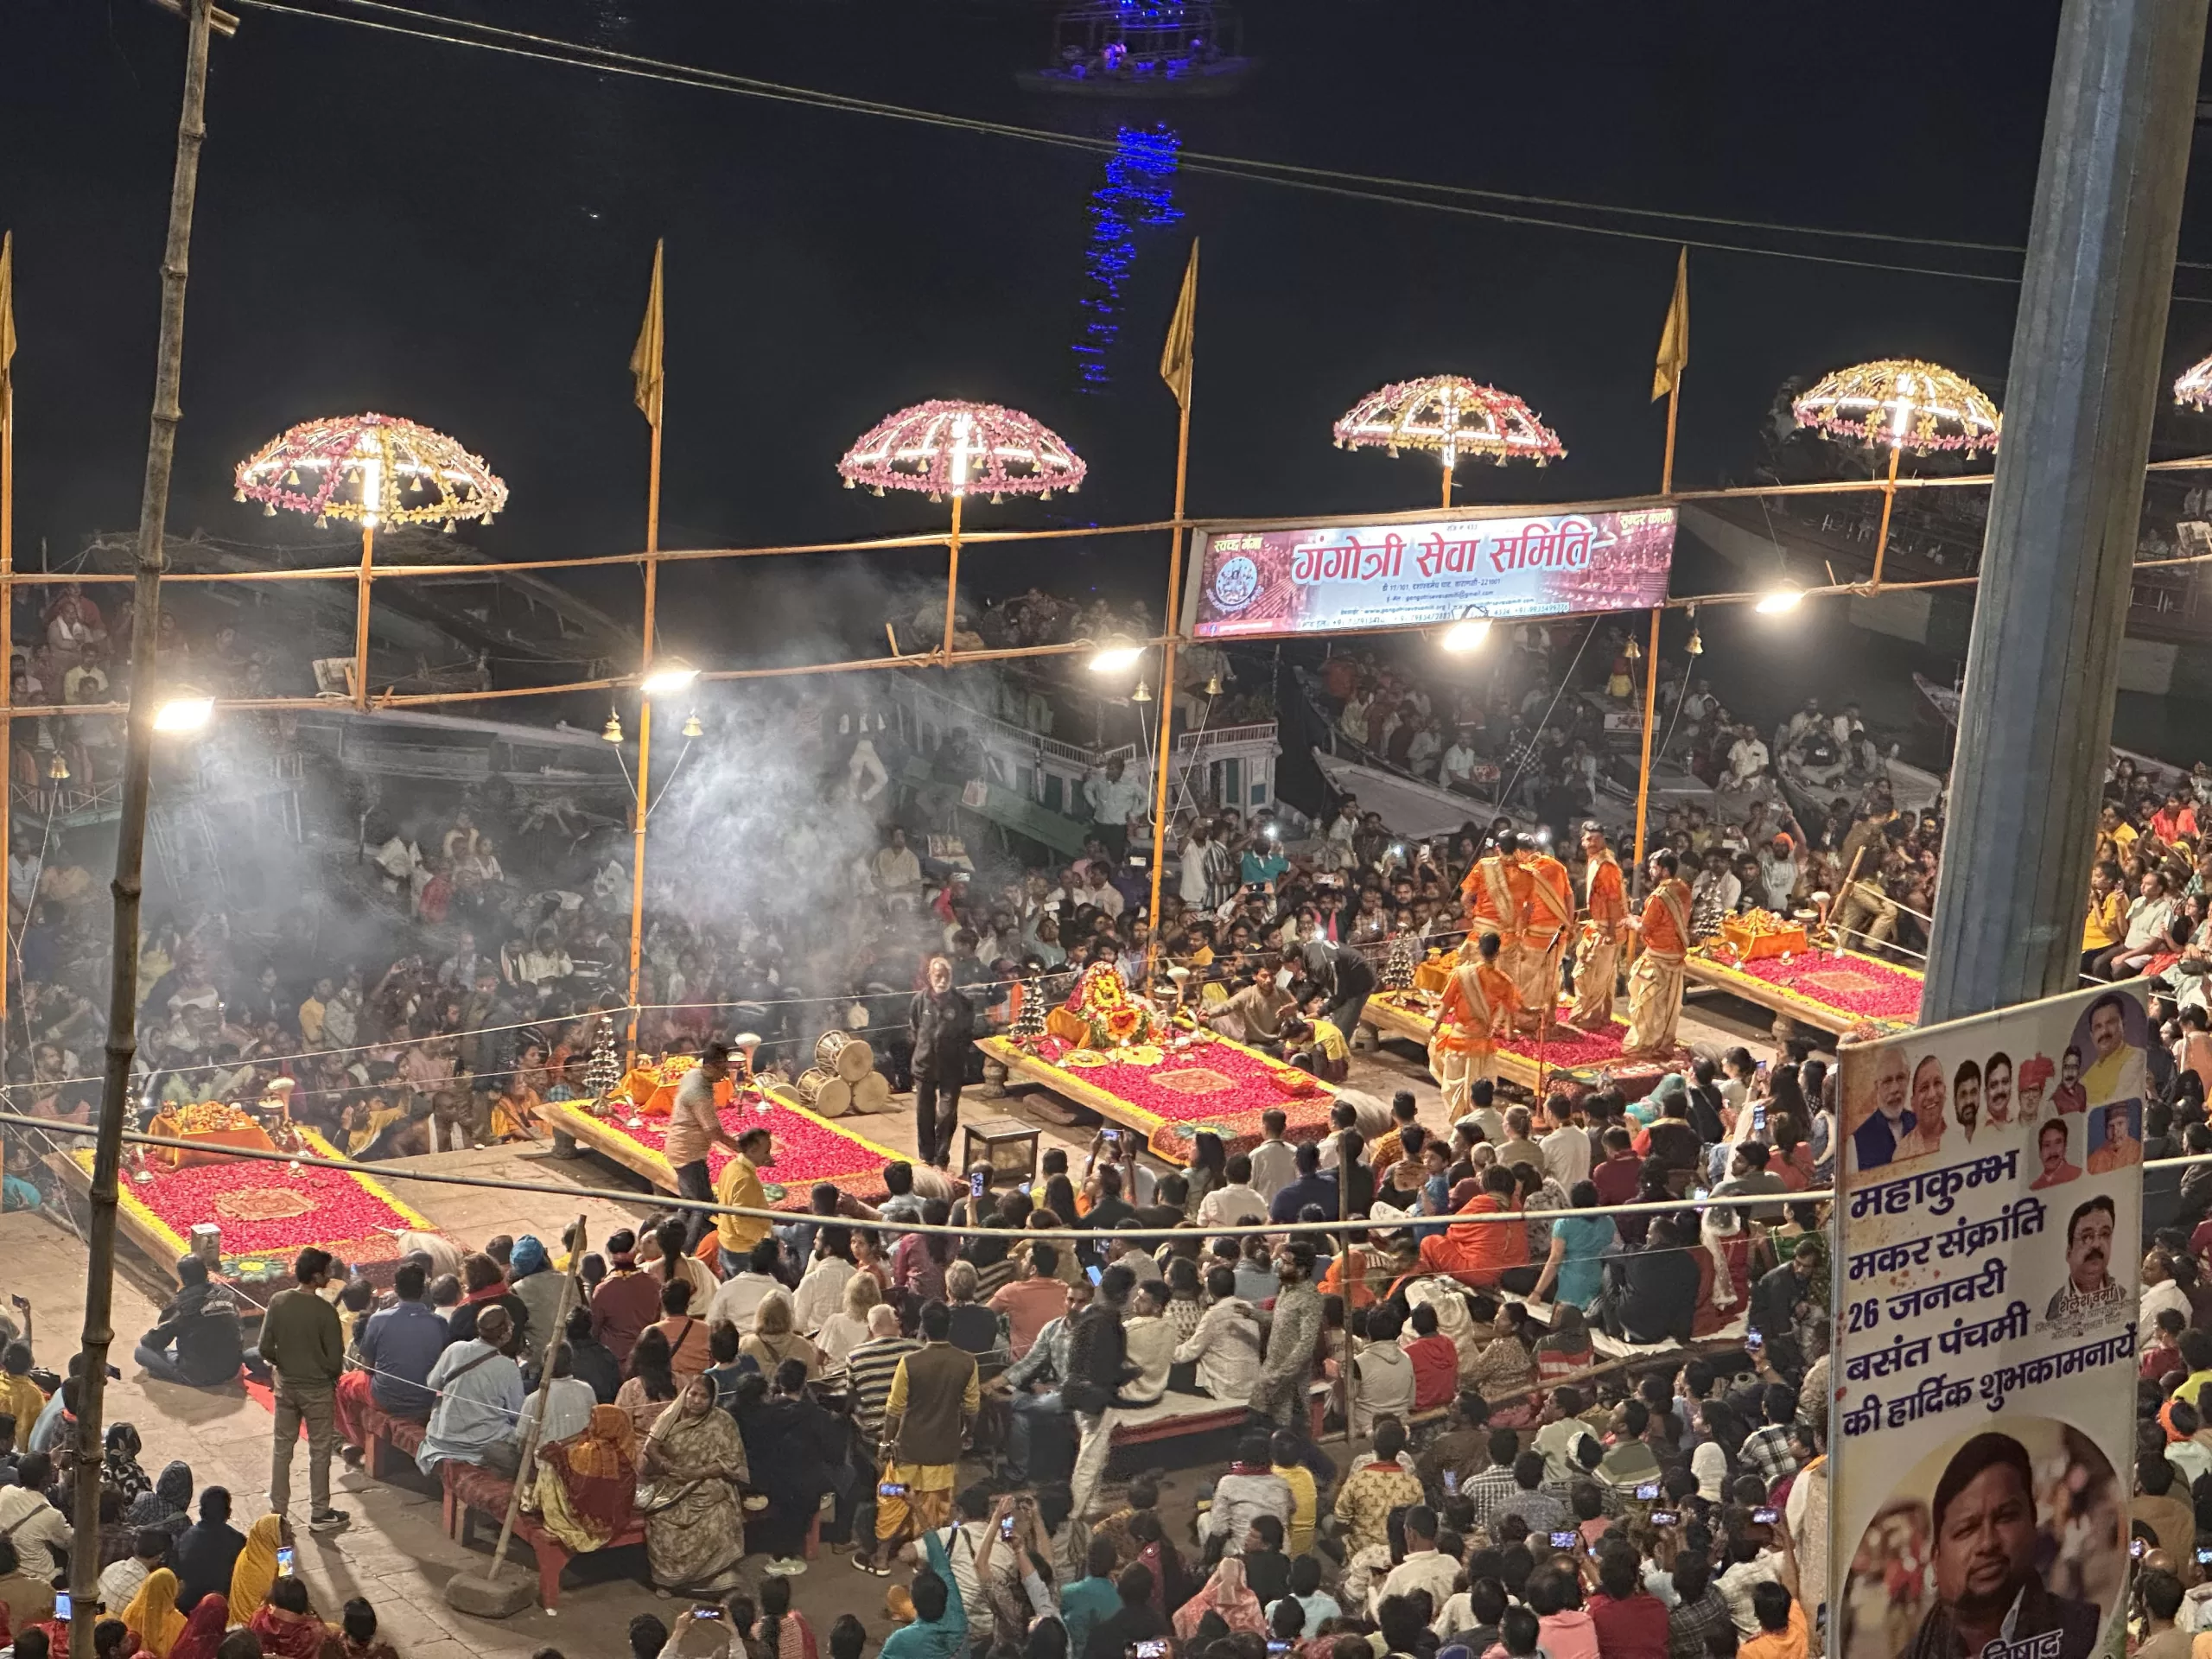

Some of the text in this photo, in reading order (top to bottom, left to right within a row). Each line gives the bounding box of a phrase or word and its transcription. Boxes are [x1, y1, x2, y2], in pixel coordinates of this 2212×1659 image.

[1242, 535, 1263, 550] गंगा
[1648, 508, 1673, 525] काशी
[1295, 520, 1593, 581] गंगोत्री सेवा समिति
[1850, 1148, 2019, 1219] महाकुम्भ
[1848, 1197, 2047, 1281] मकर संक्रांति
[1847, 1257, 2007, 1334] 26 जनवरी
[1846, 1300, 2031, 1382] बसंत पंचमी
[1842, 1394, 1883, 1437] की
[1887, 1373, 1975, 1428] हार्दिक
